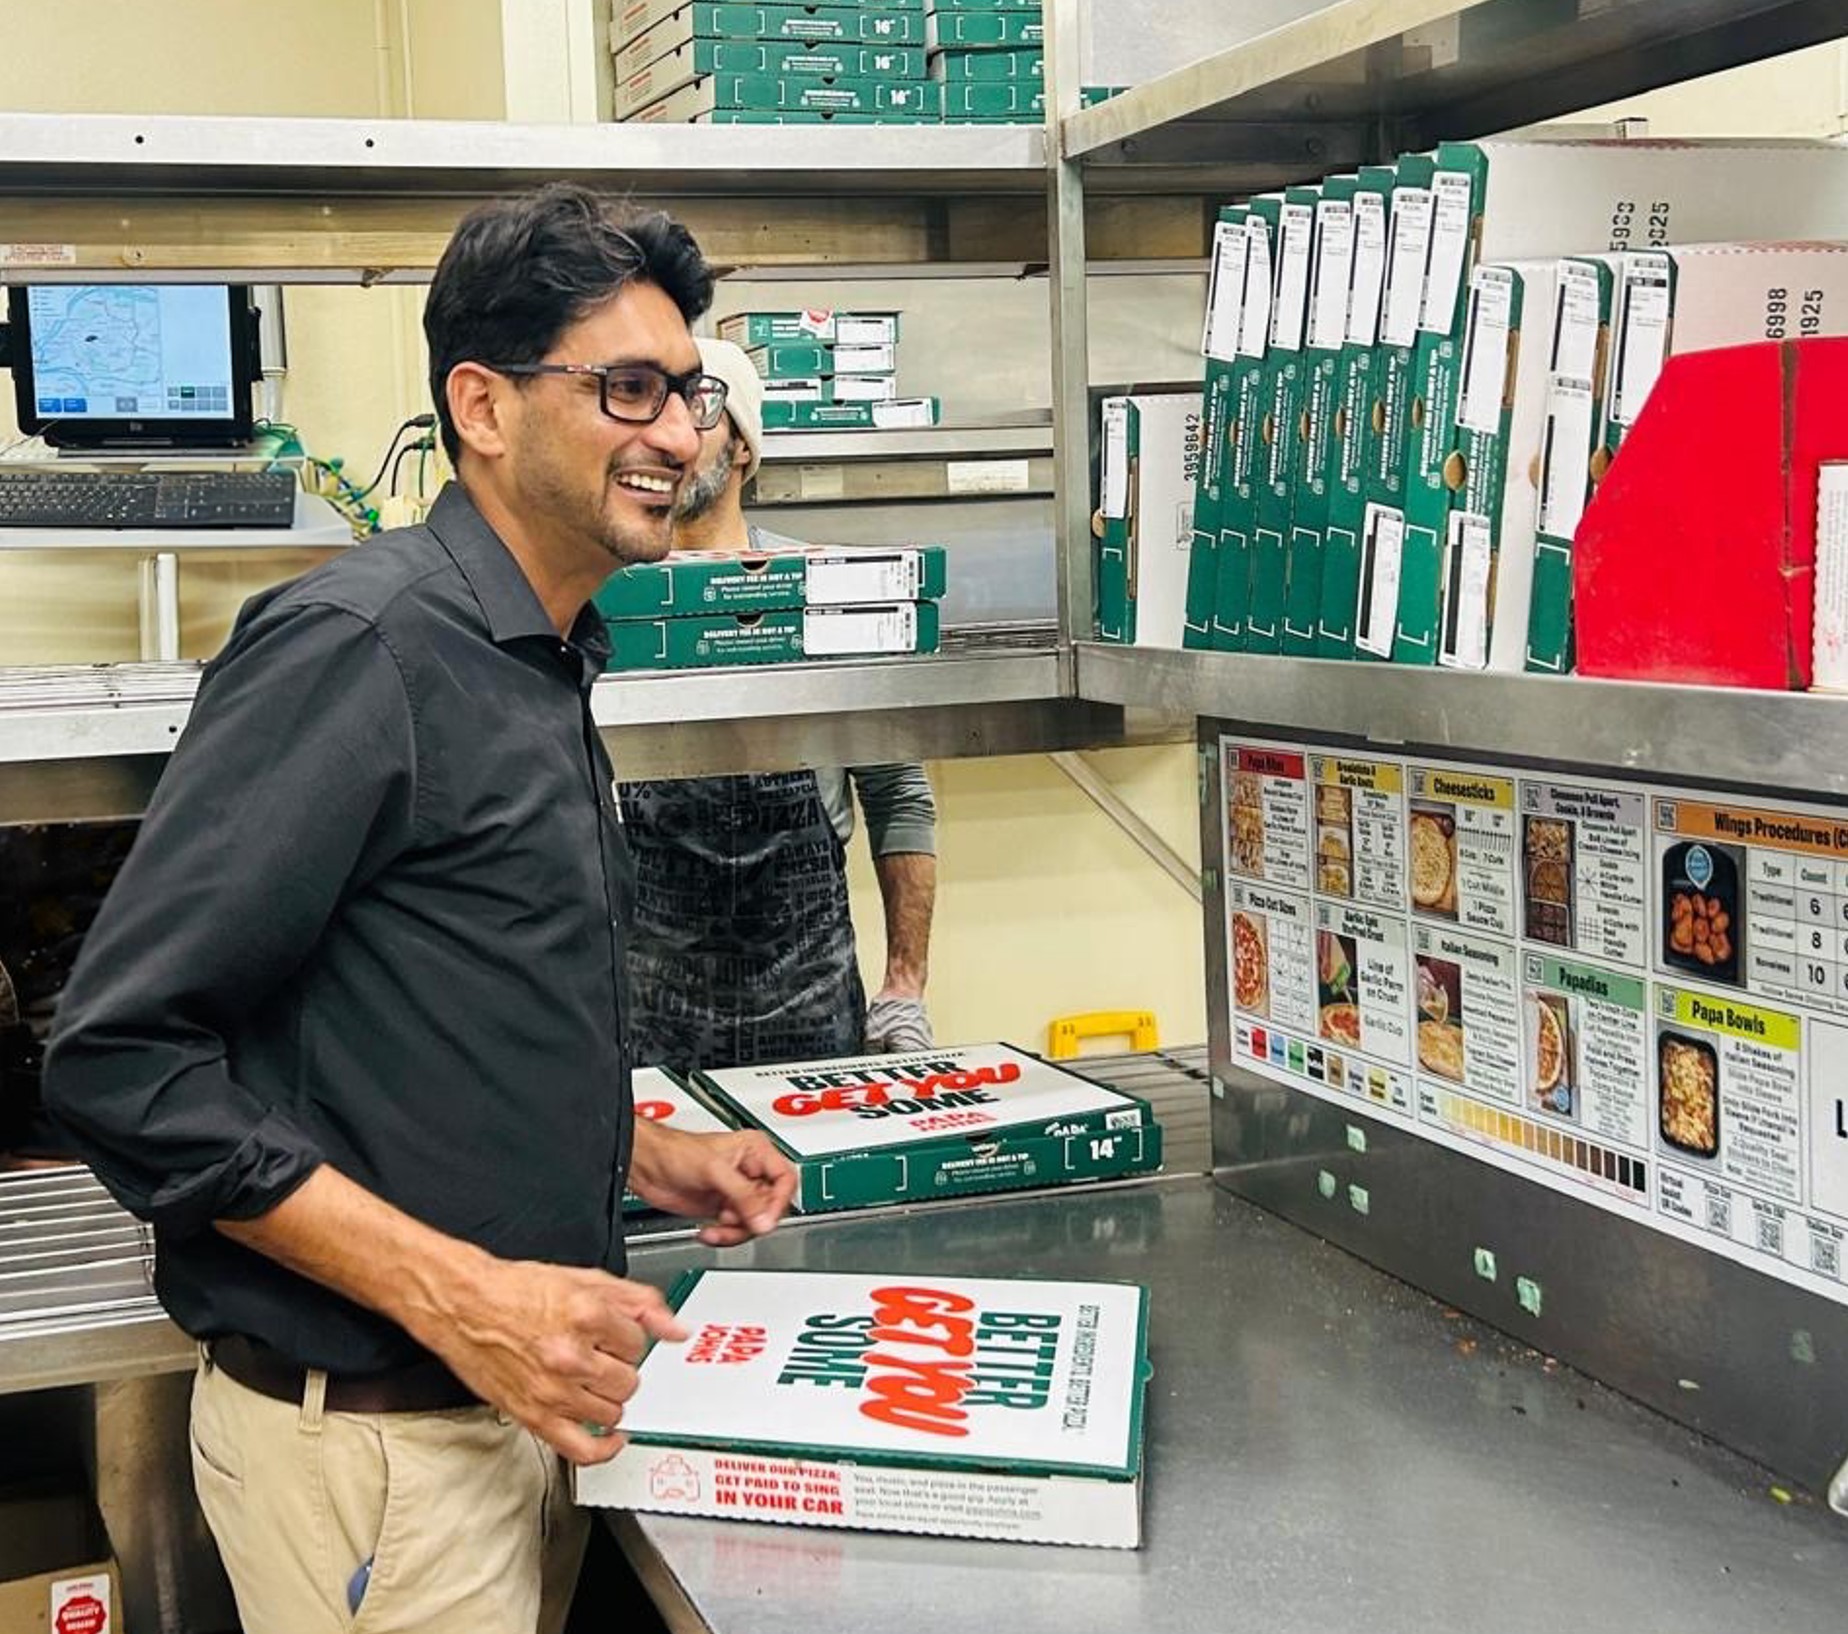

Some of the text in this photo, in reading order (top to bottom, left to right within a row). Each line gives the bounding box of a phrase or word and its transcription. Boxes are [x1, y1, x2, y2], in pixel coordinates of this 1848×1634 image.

[1766, 287, 1788, 338] 6998
[710, 576, 744, 584] DELIVERY
[704, 629, 738, 638] DELIVERY
[762, 627, 776, 635] NOT
[1433, 778, 1494, 801] Cheesesticks
[1714, 813, 1751, 838] Wings
[1755, 818, 1830, 846] Procedures
[1762, 863, 1781, 877] Type
[1811, 898, 1820, 915] 6
[1812, 932, 1821, 949] 8
[1559, 967, 1608, 997] Papadias
[1808, 965, 1824, 985] 10
[1692, 1000, 1764, 1035] Papa Bowls
[772, 1063, 1022, 1116] GET YOU
[787, 1061, 966, 1091] BETTER
[851, 1088, 1000, 1119] SOME
[1089, 1136, 1122, 1160] 14"
[716, 1326, 768, 1364] PAPA
[777, 1314, 880, 1388] SOME
[858, 1286, 976, 1438] GET YOU
[962, 1310, 1062, 1411] BETTER
[715, 1459, 765, 1473] DELIVER
[770, 1464, 796, 1477] OUR
[715, 1475, 839, 1495] GET PAID TO SING
[715, 1490, 843, 1514] IN YOUR CAR
